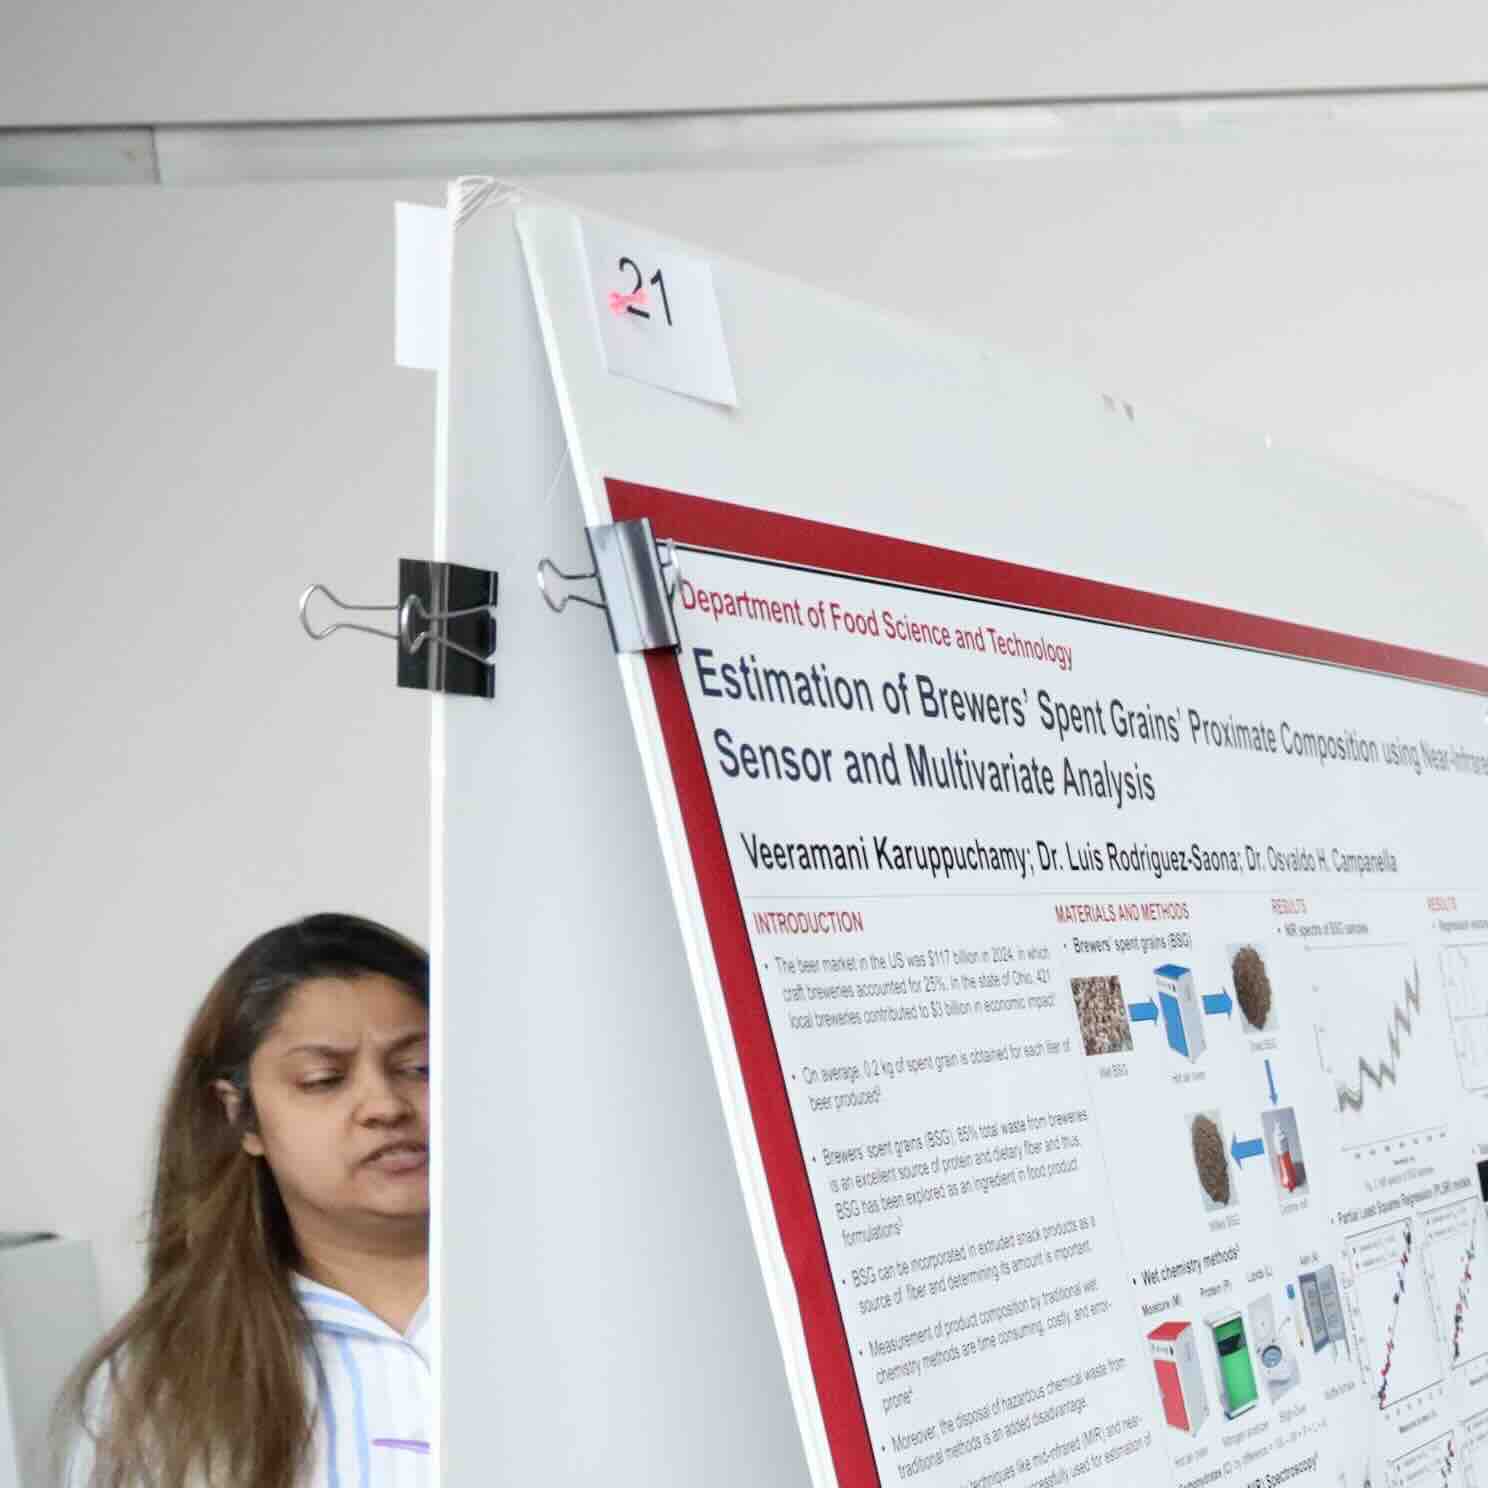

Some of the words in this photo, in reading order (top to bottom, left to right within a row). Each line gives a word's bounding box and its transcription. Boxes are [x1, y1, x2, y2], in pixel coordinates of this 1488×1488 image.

[618, 256, 673, 327] 21
[676, 577, 804, 626] Department
[807, 599, 827, 630] of
[828, 601, 880, 637] Food
[881, 610, 952, 648] Science
[954, 626, 986, 652] and
[985, 627, 1072, 671] Technology
[691, 647, 874, 712] Estimation
[881, 671, 911, 716] of
[914, 673, 1028, 728] Brewers'
[1037, 689, 1107, 742] Spent
[1109, 698, 1180, 743] Grains'
[1187, 708, 1277, 753] Proximate
[1279, 720, 1378, 763] Composition
[1382, 743, 1421, 776] using
[712, 727, 832, 782] Sensor
[843, 741, 902, 786] and
[904, 743, 1055, 795] Multivariate
[1063, 756, 1156, 810] Analysis
[739, 832, 869, 870] Veeramani
[872, 835, 1034, 880] Karuppuchamy;
[1035, 839, 1063, 871] Dr.
[1064, 841, 1104, 871] Luis
[1105, 842, 1243, 879] Rodriguez-Saona;
[1244, 844, 1264, 871] Dr.
[1266, 845, 1316, 872] Osvaldo
[752, 911, 864, 934] INTRODUCTION
[1054, 903, 1117, 924] MATERIALS
[1118, 903, 1140, 921] AND
[1140, 902, 1190, 921] METHODS
[1113, 935, 1140, 953] spent
[1139, 934, 1167, 953] grains
[773, 953, 796, 974] The
[1140, 1267, 1161, 1286] Wet
[1159, 1258, 1202, 1281] chemistry
